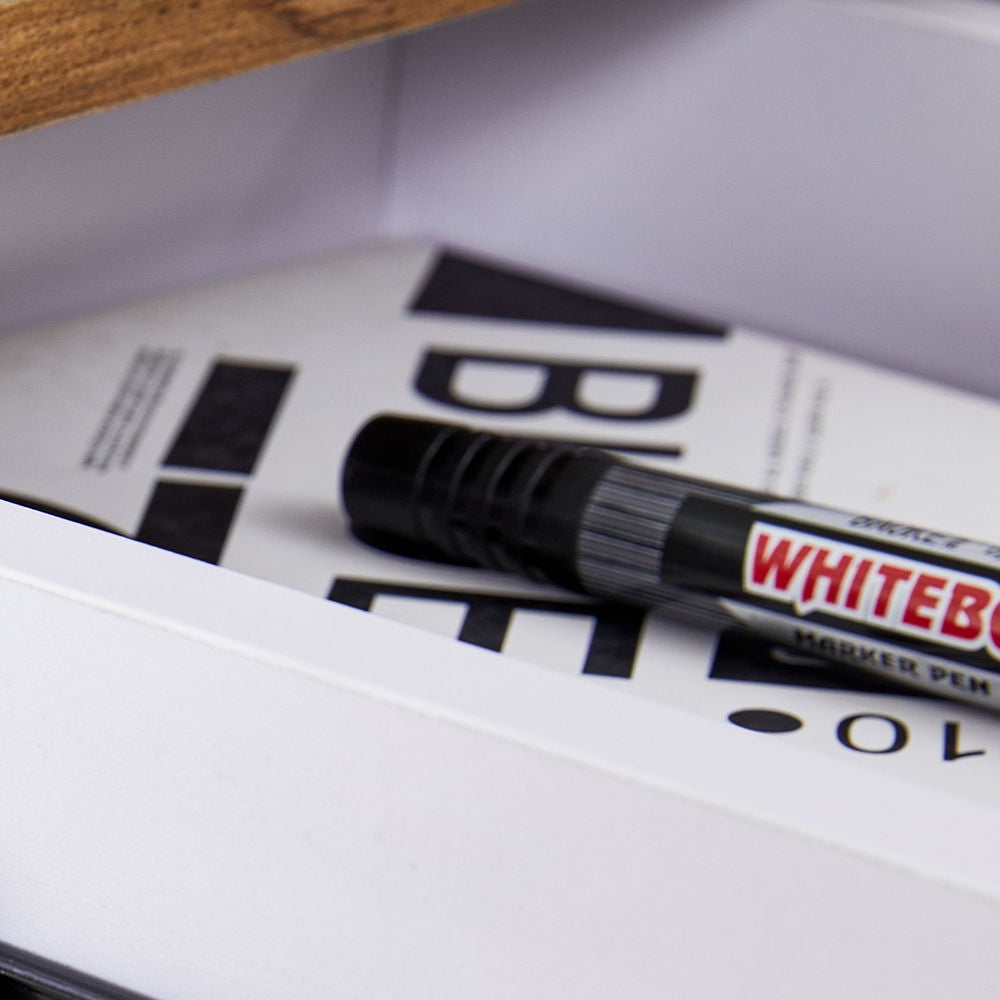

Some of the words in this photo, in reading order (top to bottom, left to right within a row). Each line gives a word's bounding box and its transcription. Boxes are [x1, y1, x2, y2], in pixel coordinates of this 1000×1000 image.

[752, 533, 1000, 652] WHITEB
[794, 629, 920, 681] MARKER
[928, 664, 992, 697] PEN
